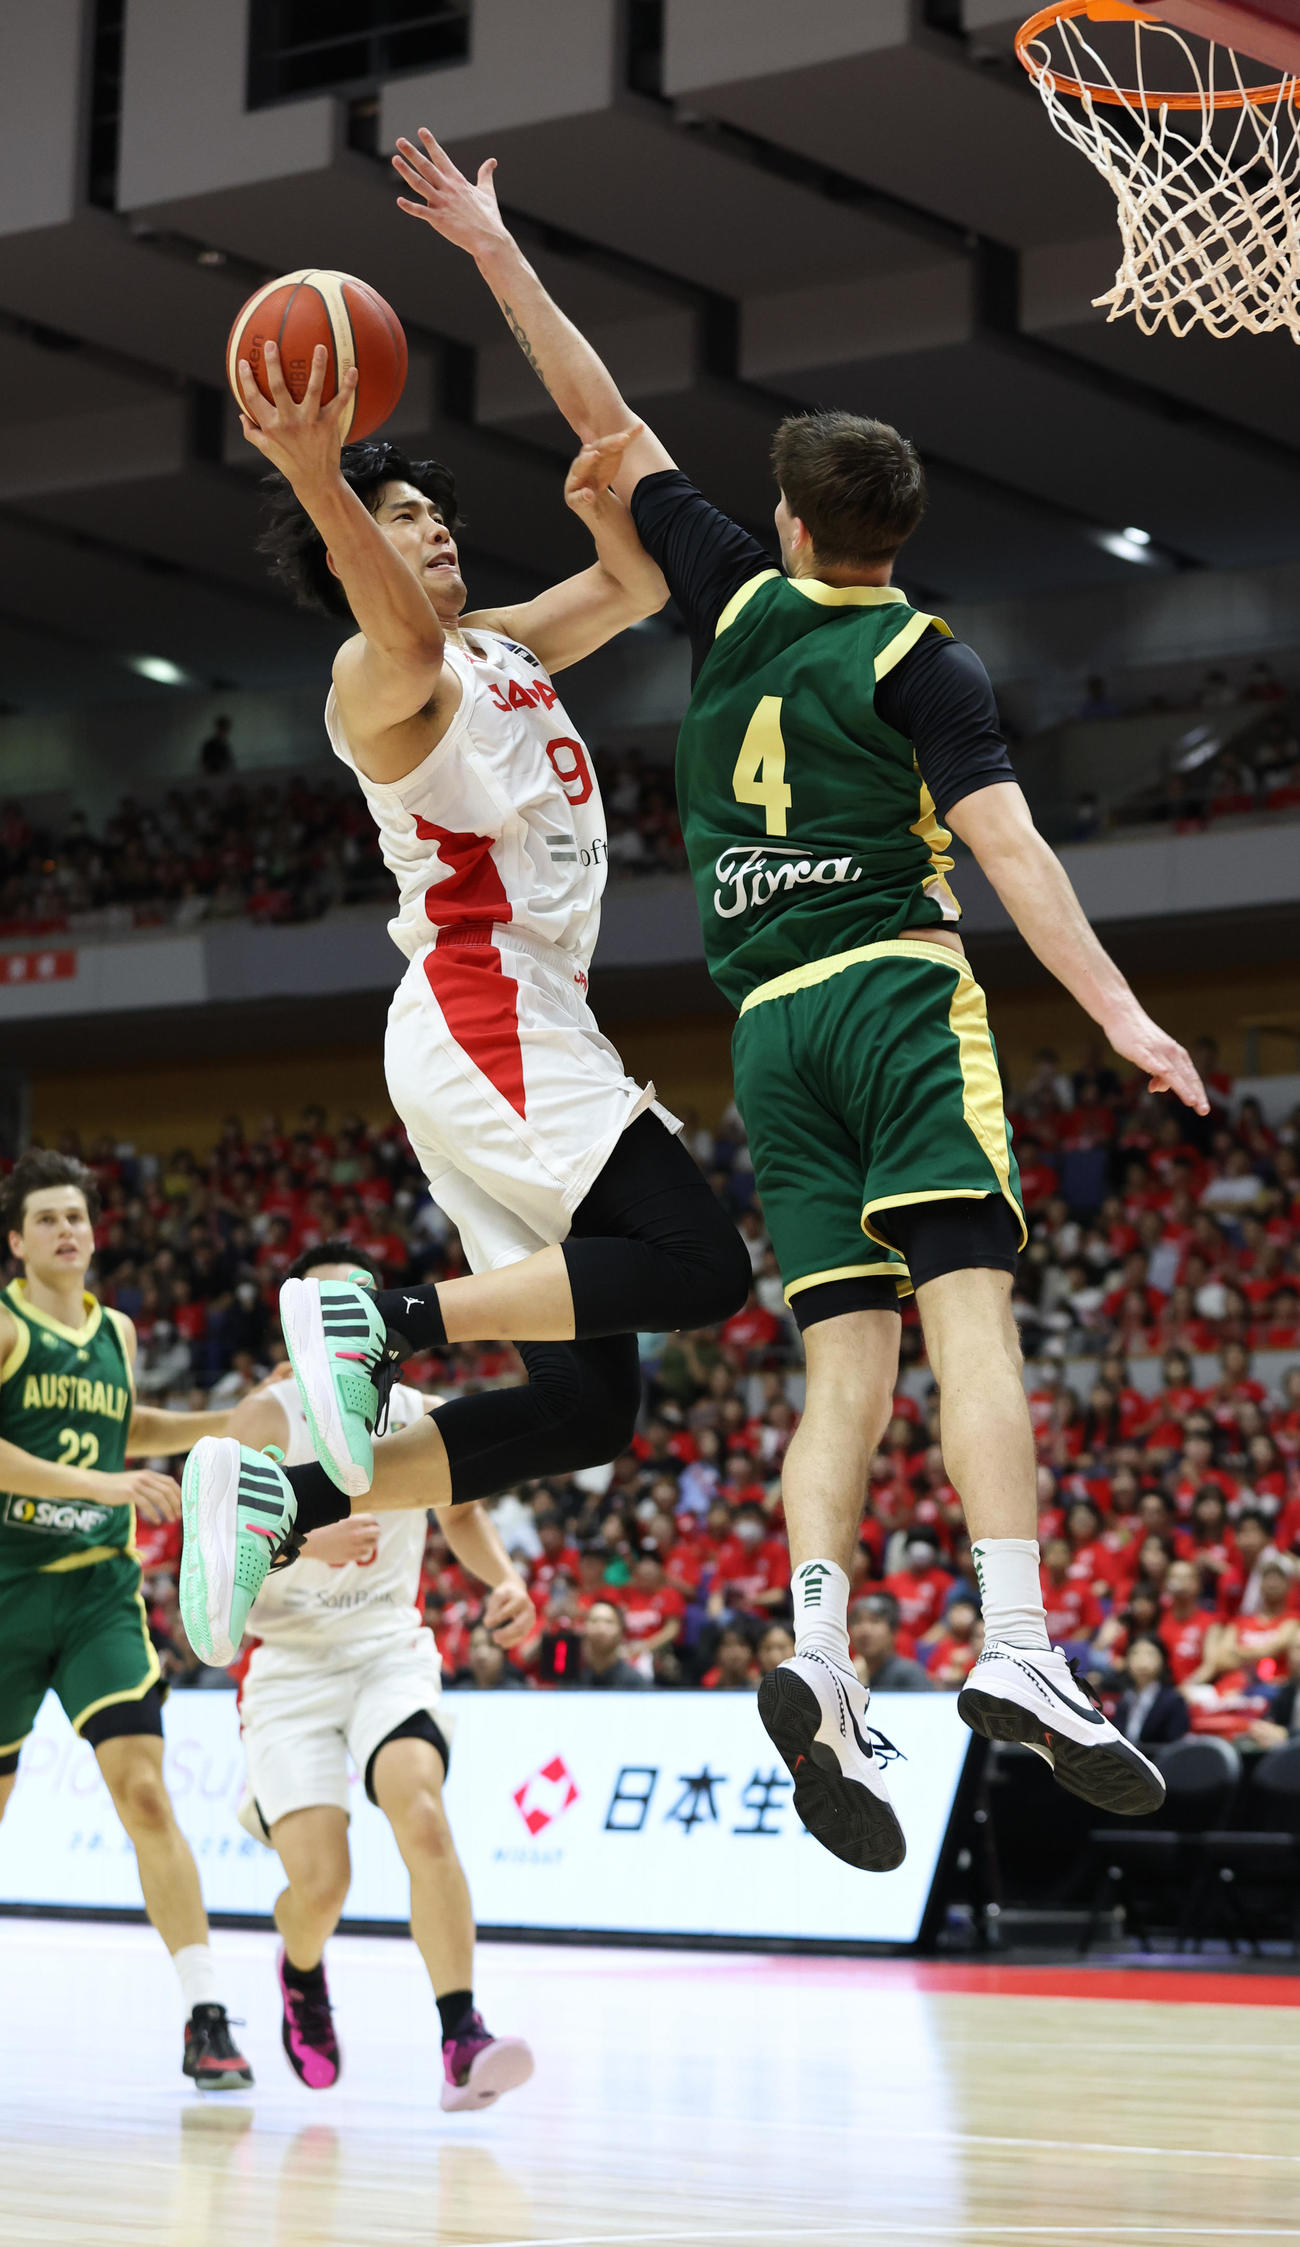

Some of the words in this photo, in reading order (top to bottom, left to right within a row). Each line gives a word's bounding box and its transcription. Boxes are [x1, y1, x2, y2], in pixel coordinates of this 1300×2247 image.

[546, 736, 593, 806] 9
[732, 695, 792, 837] 4
[58, 1427, 99, 1470] 22
[603, 1764, 806, 1836] 日本生
